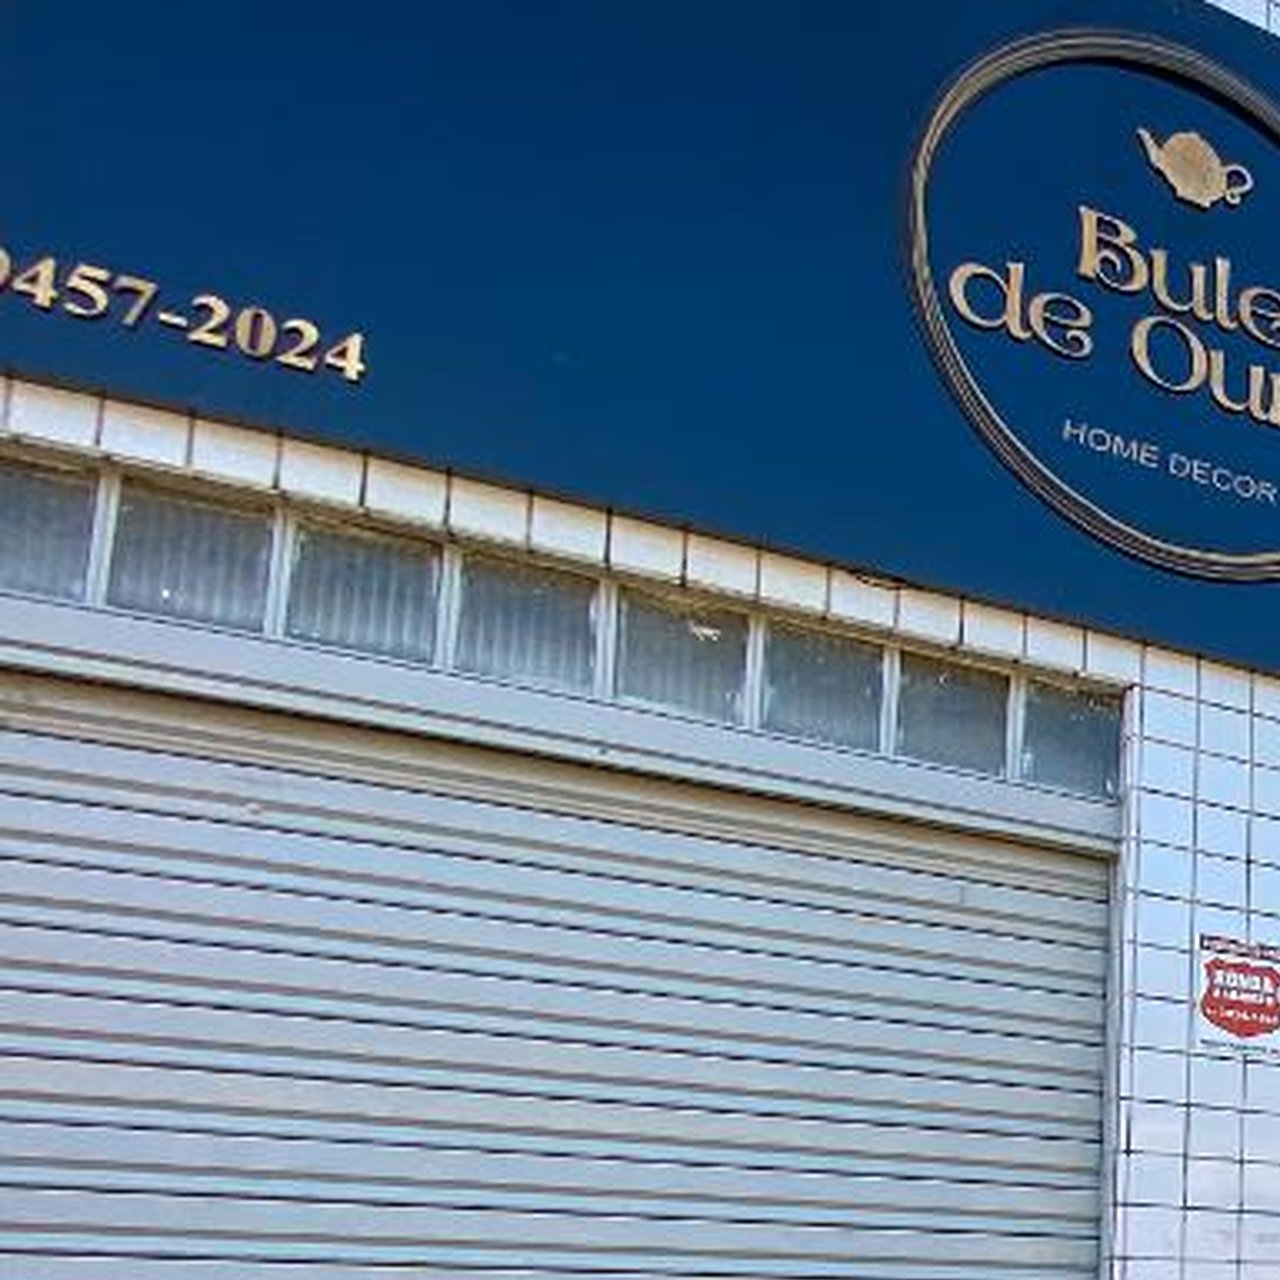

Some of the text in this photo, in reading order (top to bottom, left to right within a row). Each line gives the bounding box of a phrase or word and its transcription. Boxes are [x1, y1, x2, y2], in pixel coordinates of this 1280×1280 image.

[0, 246, 367, 382] 457-2024
[948, 261, 1094, 359] de
[1062, 419, 1279, 504] HOME DECOR
